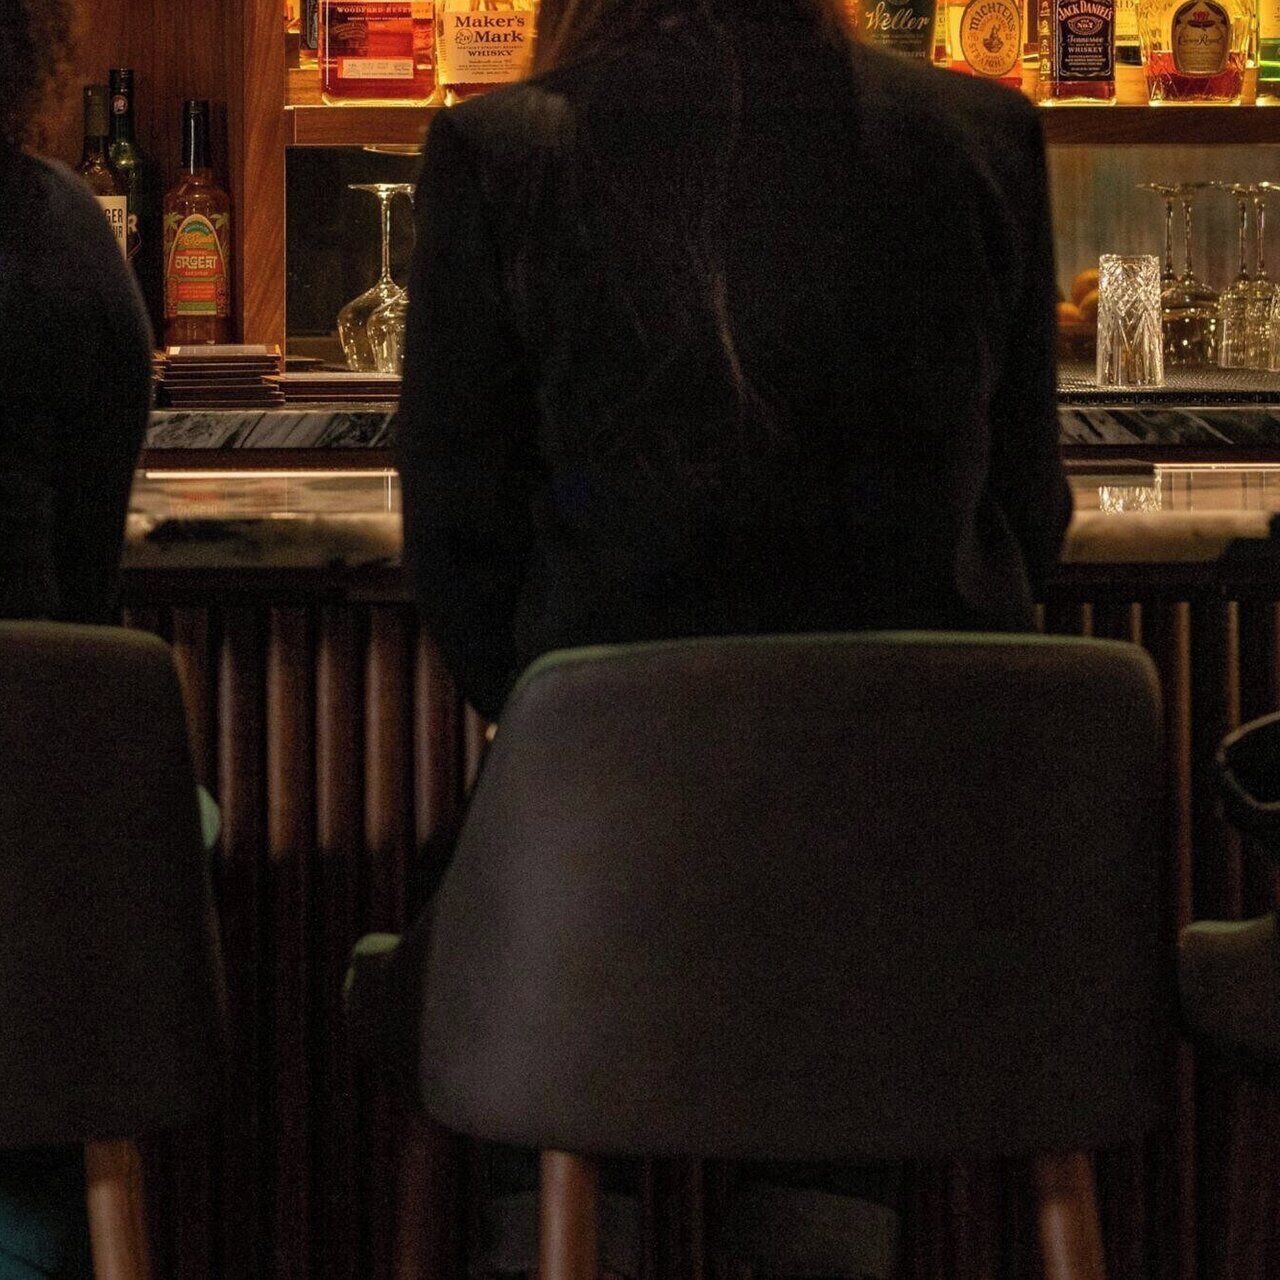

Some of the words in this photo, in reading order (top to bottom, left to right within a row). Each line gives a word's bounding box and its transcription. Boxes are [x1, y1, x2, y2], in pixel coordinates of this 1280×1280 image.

[866, 2, 930, 30] Weller
[1059, 4, 1080, 20] JACK
[1080, 0, 1113, 20] DANIEL'S
[455, 16, 525, 27] Maker's
[475, 31, 524, 43] Mark
